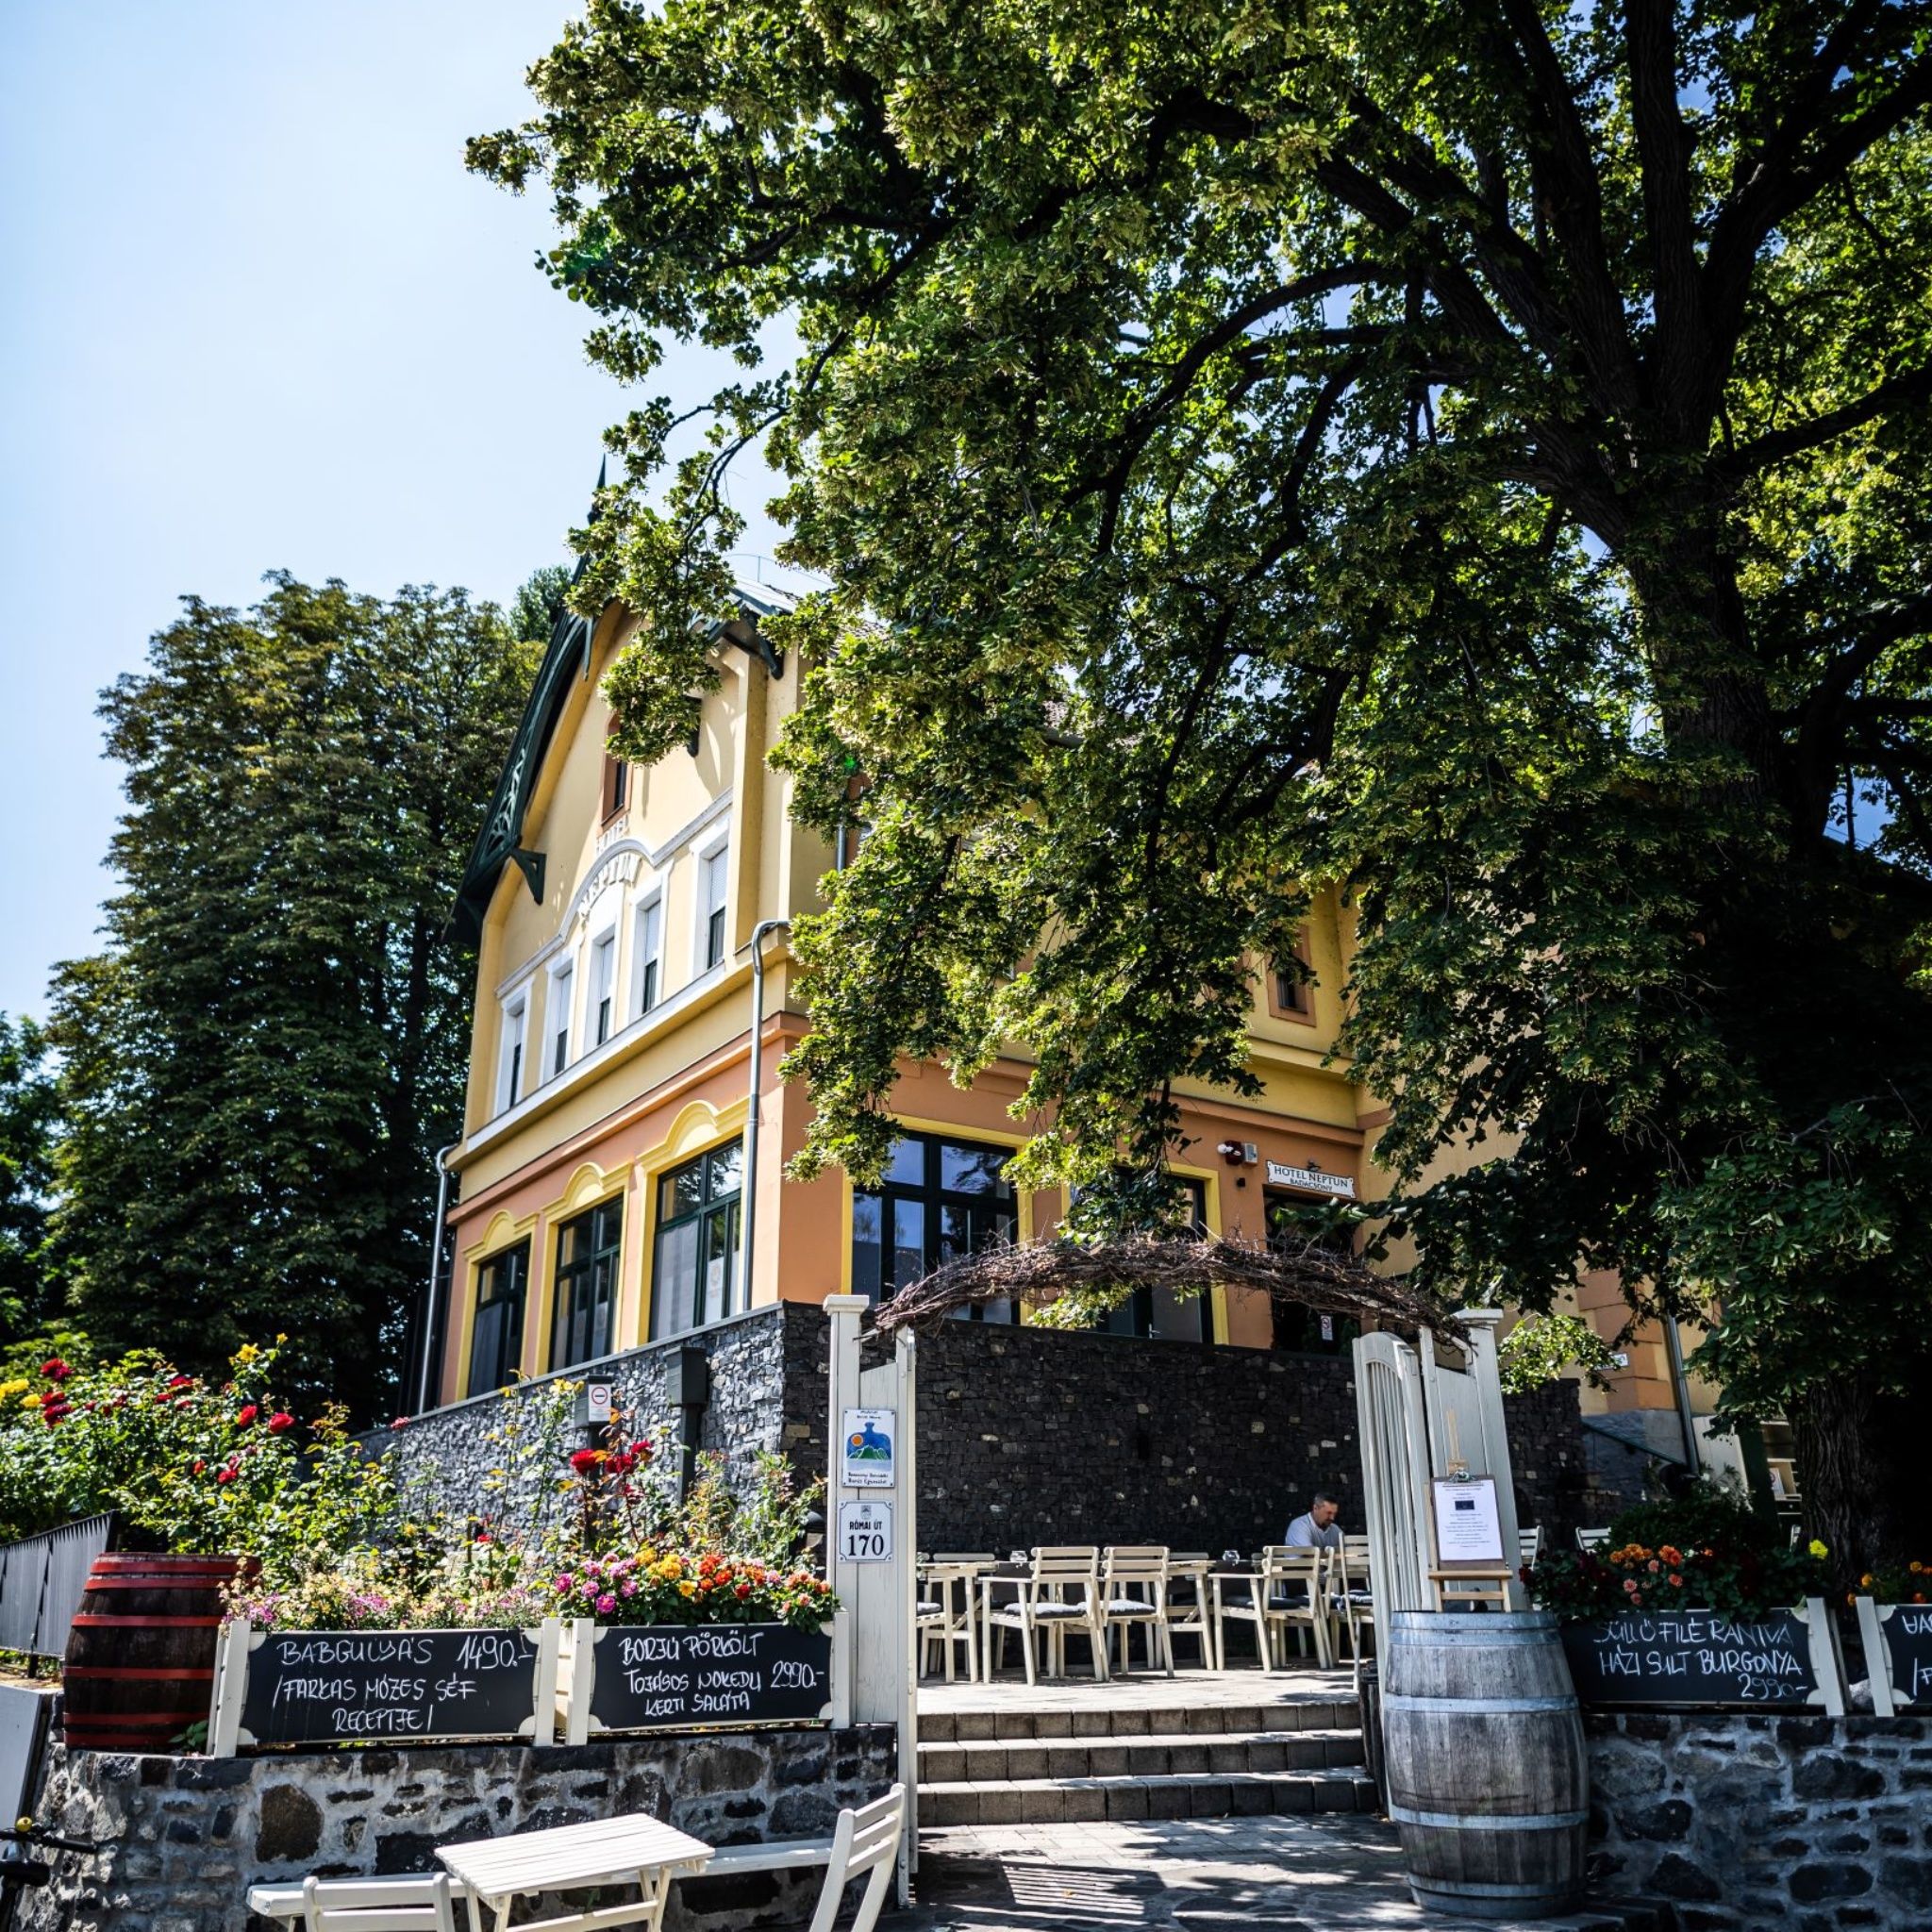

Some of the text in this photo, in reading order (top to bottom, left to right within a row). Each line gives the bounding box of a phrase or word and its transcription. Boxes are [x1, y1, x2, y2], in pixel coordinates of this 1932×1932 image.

[1274, 1166, 1348, 1188] HOTEL NEPTUN
[1290, 1177, 1333, 1191] BADACSONY
[849, 1520, 883, 1530] RÓMAI ÚT
[848, 1534, 885, 1557] 170
[1695, 1648, 1804, 1676] BURGONYA
[365, 1674, 426, 1701] MÓZES
[645, 1690, 751, 1717] KERTI SALÁTA
